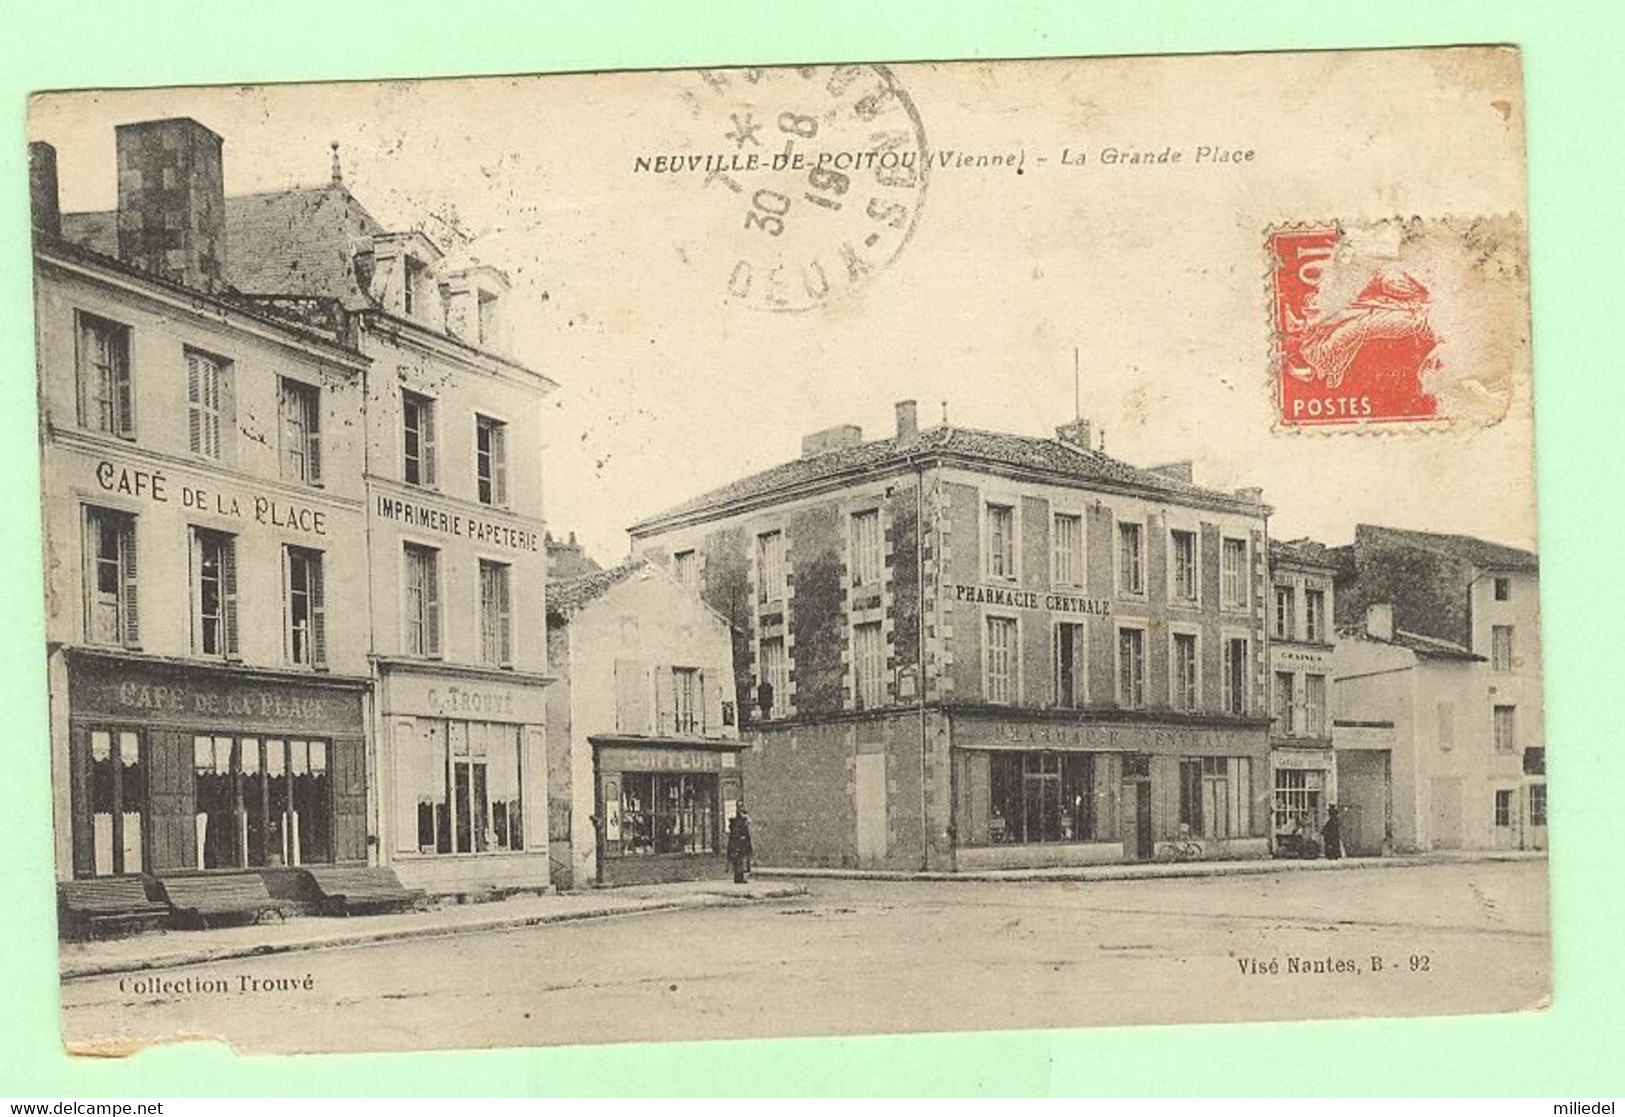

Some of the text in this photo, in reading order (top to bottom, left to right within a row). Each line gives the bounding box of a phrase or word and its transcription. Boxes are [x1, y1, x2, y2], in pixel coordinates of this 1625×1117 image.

[633, 150, 917, 174] NEUVILLE-DE-POITOU
[927, 148, 1026, 170] (Vienne)
[1060, 147, 1088, 166] La
[1100, 146, 1183, 165] Grande
[1195, 145, 1256, 164] Place
[1293, 397, 1373, 416] POSTES
[96, 461, 327, 536] CAFÉ DE LA PLACE
[377, 495, 538, 552] IMPRIMERIE PAPETERIE
[955, 584, 1040, 610] PHARMACIE
[258, 691, 328, 721] PLACE
[1237, 956, 1280, 975] Visé
[1287, 956, 1362, 975] Nantes,
[1370, 955, 1384, 972] B
[1409, 954, 1431, 972] 92
[119, 973, 315, 995] Collection Trouvé
